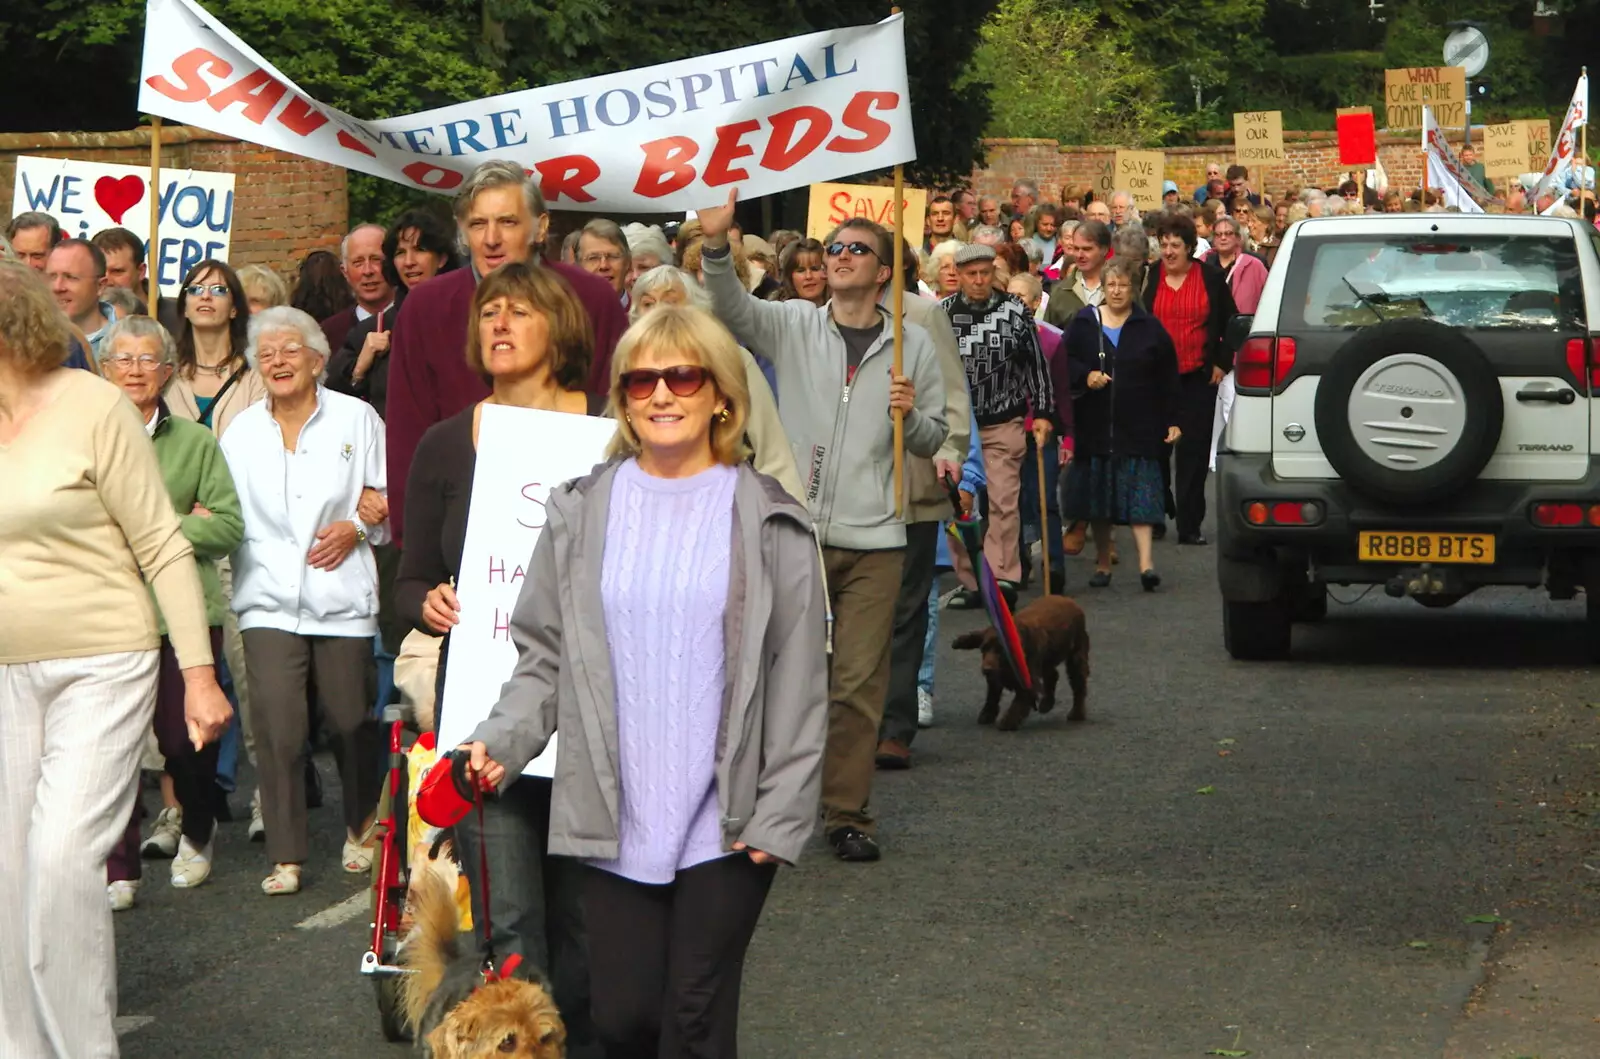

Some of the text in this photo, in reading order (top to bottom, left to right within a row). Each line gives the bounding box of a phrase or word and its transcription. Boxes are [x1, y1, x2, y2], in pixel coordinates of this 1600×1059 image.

[1406, 67, 1442, 83] WHAT
[541, 42, 858, 140] HOSPITAL
[1421, 83, 1433, 100] IN
[1434, 82, 1452, 100] THE
[1243, 112, 1268, 124] SAVE
[1387, 101, 1463, 128] COMMITY?
[1246, 128, 1269, 140] OUR
[1487, 125, 1517, 137] SAVE
[401, 153, 601, 203] OR
[632, 90, 900, 199] BEDS
[1238, 147, 1281, 159] HOSPITAL
[1527, 140, 1547, 156] UR
[1121, 159, 1154, 176] SAVE
[1100, 176, 1115, 190] OU
[1129, 177, 1150, 188] OUR
[22, 171, 234, 233] WE YOU
[1375, 382, 1444, 398] TERRANO
[1516, 443, 1575, 452] TERRANO
[1369, 535, 1484, 558] R888 BTS
